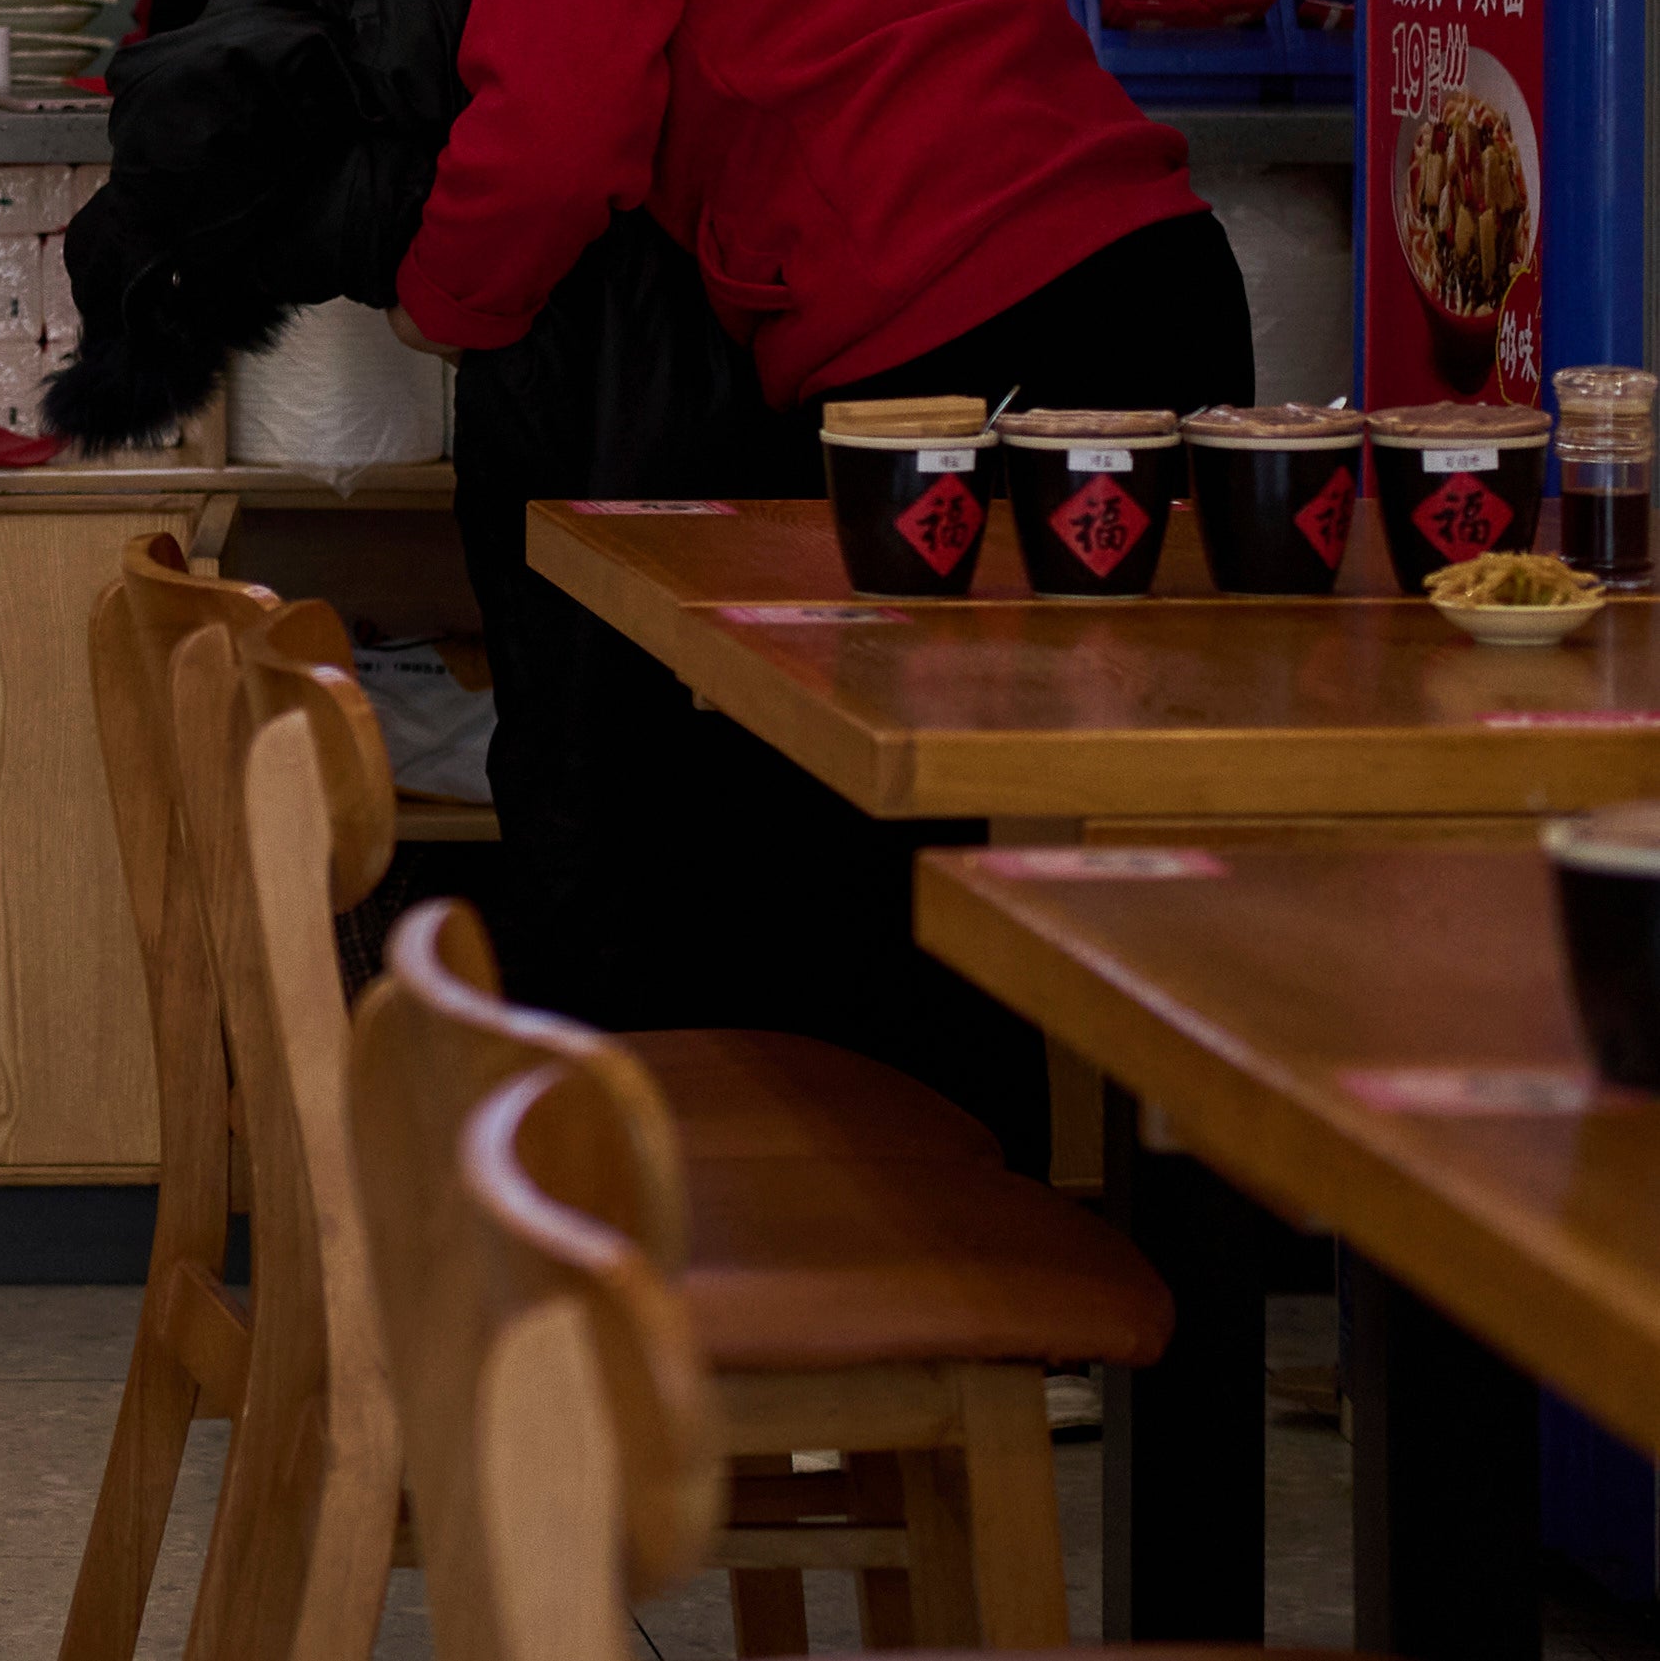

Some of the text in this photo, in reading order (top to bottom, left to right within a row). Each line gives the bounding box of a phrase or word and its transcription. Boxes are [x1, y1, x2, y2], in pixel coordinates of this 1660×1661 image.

[1390, 21, 1427, 121] 19
[916, 493, 969, 552] 福
[1070, 495, 1128, 553] 福
[1432, 490, 1491, 546] 福
